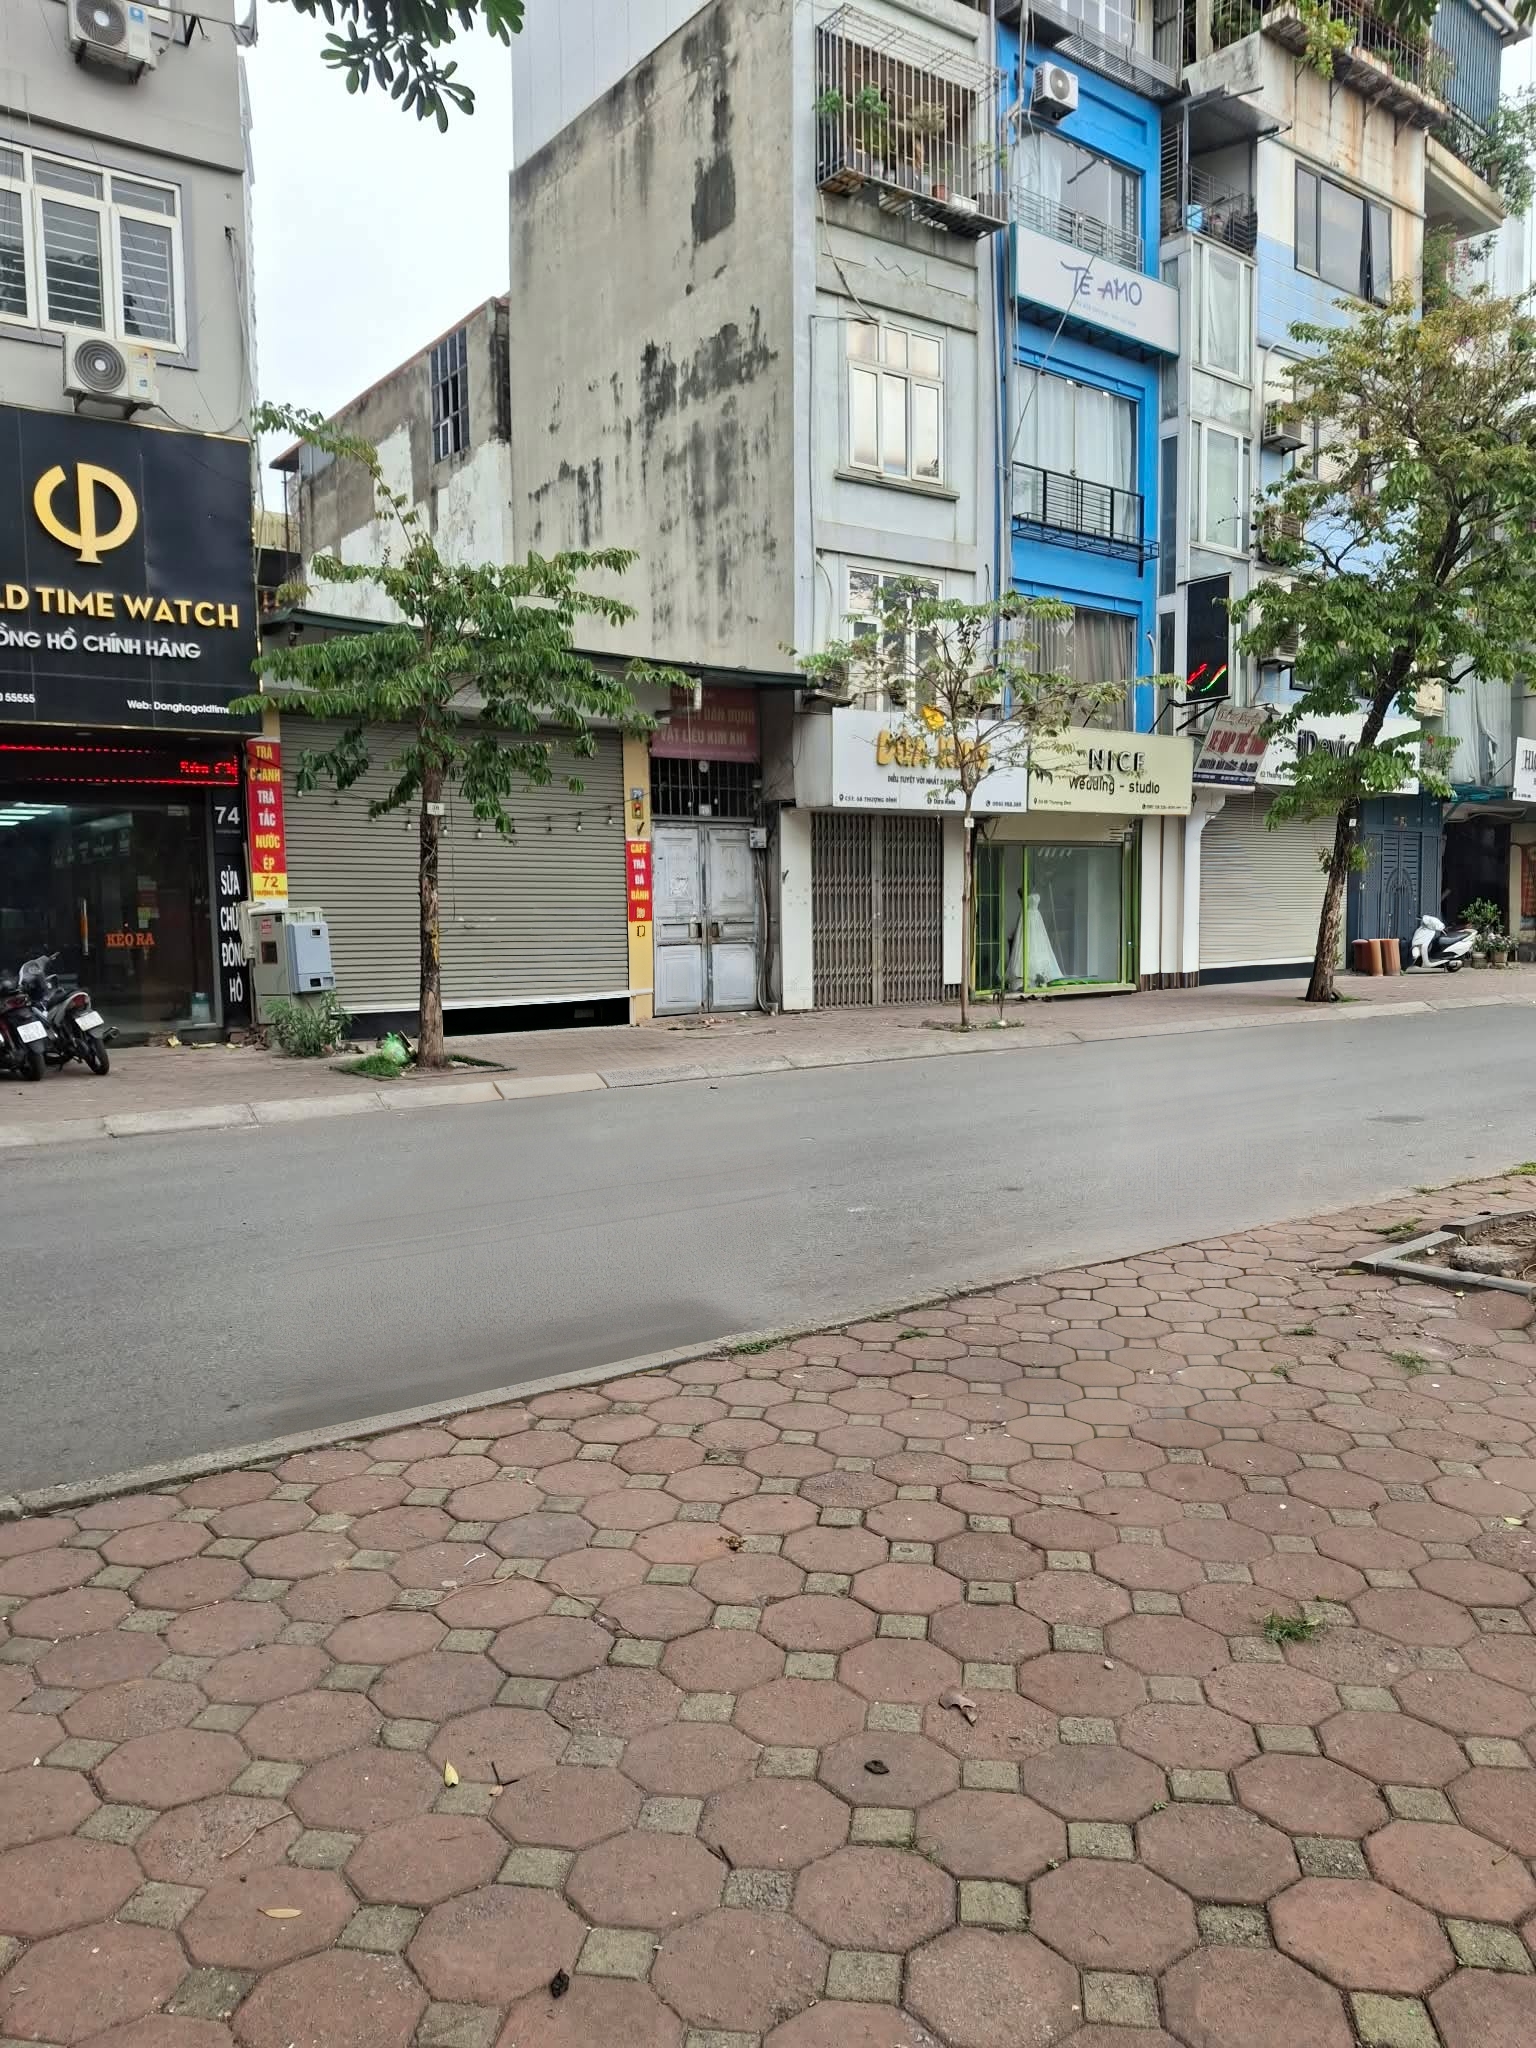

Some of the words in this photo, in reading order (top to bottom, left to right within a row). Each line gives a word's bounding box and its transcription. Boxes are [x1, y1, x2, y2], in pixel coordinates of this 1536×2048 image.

[1060, 260, 1093, 296] TE
[1097, 277, 1142, 306] AMO
[35, 587, 115, 618] TIME
[123, 594, 239, 628] WATCH
[46, 626, 77, 650] HỒ
[83, 632, 141, 655] CHÍNH
[145, 637, 201, 659] HÀNG
[127, 700, 153, 711] Web:
[256, 745, 273, 760] TRÀ
[1128, 781, 1160, 795] studio
[257, 789, 275, 805] TRÀ
[214, 806, 241, 825] 74
[221, 865, 241, 896] SỬA
[262, 876, 279, 888] 72
[136, 932, 156, 946] RA
